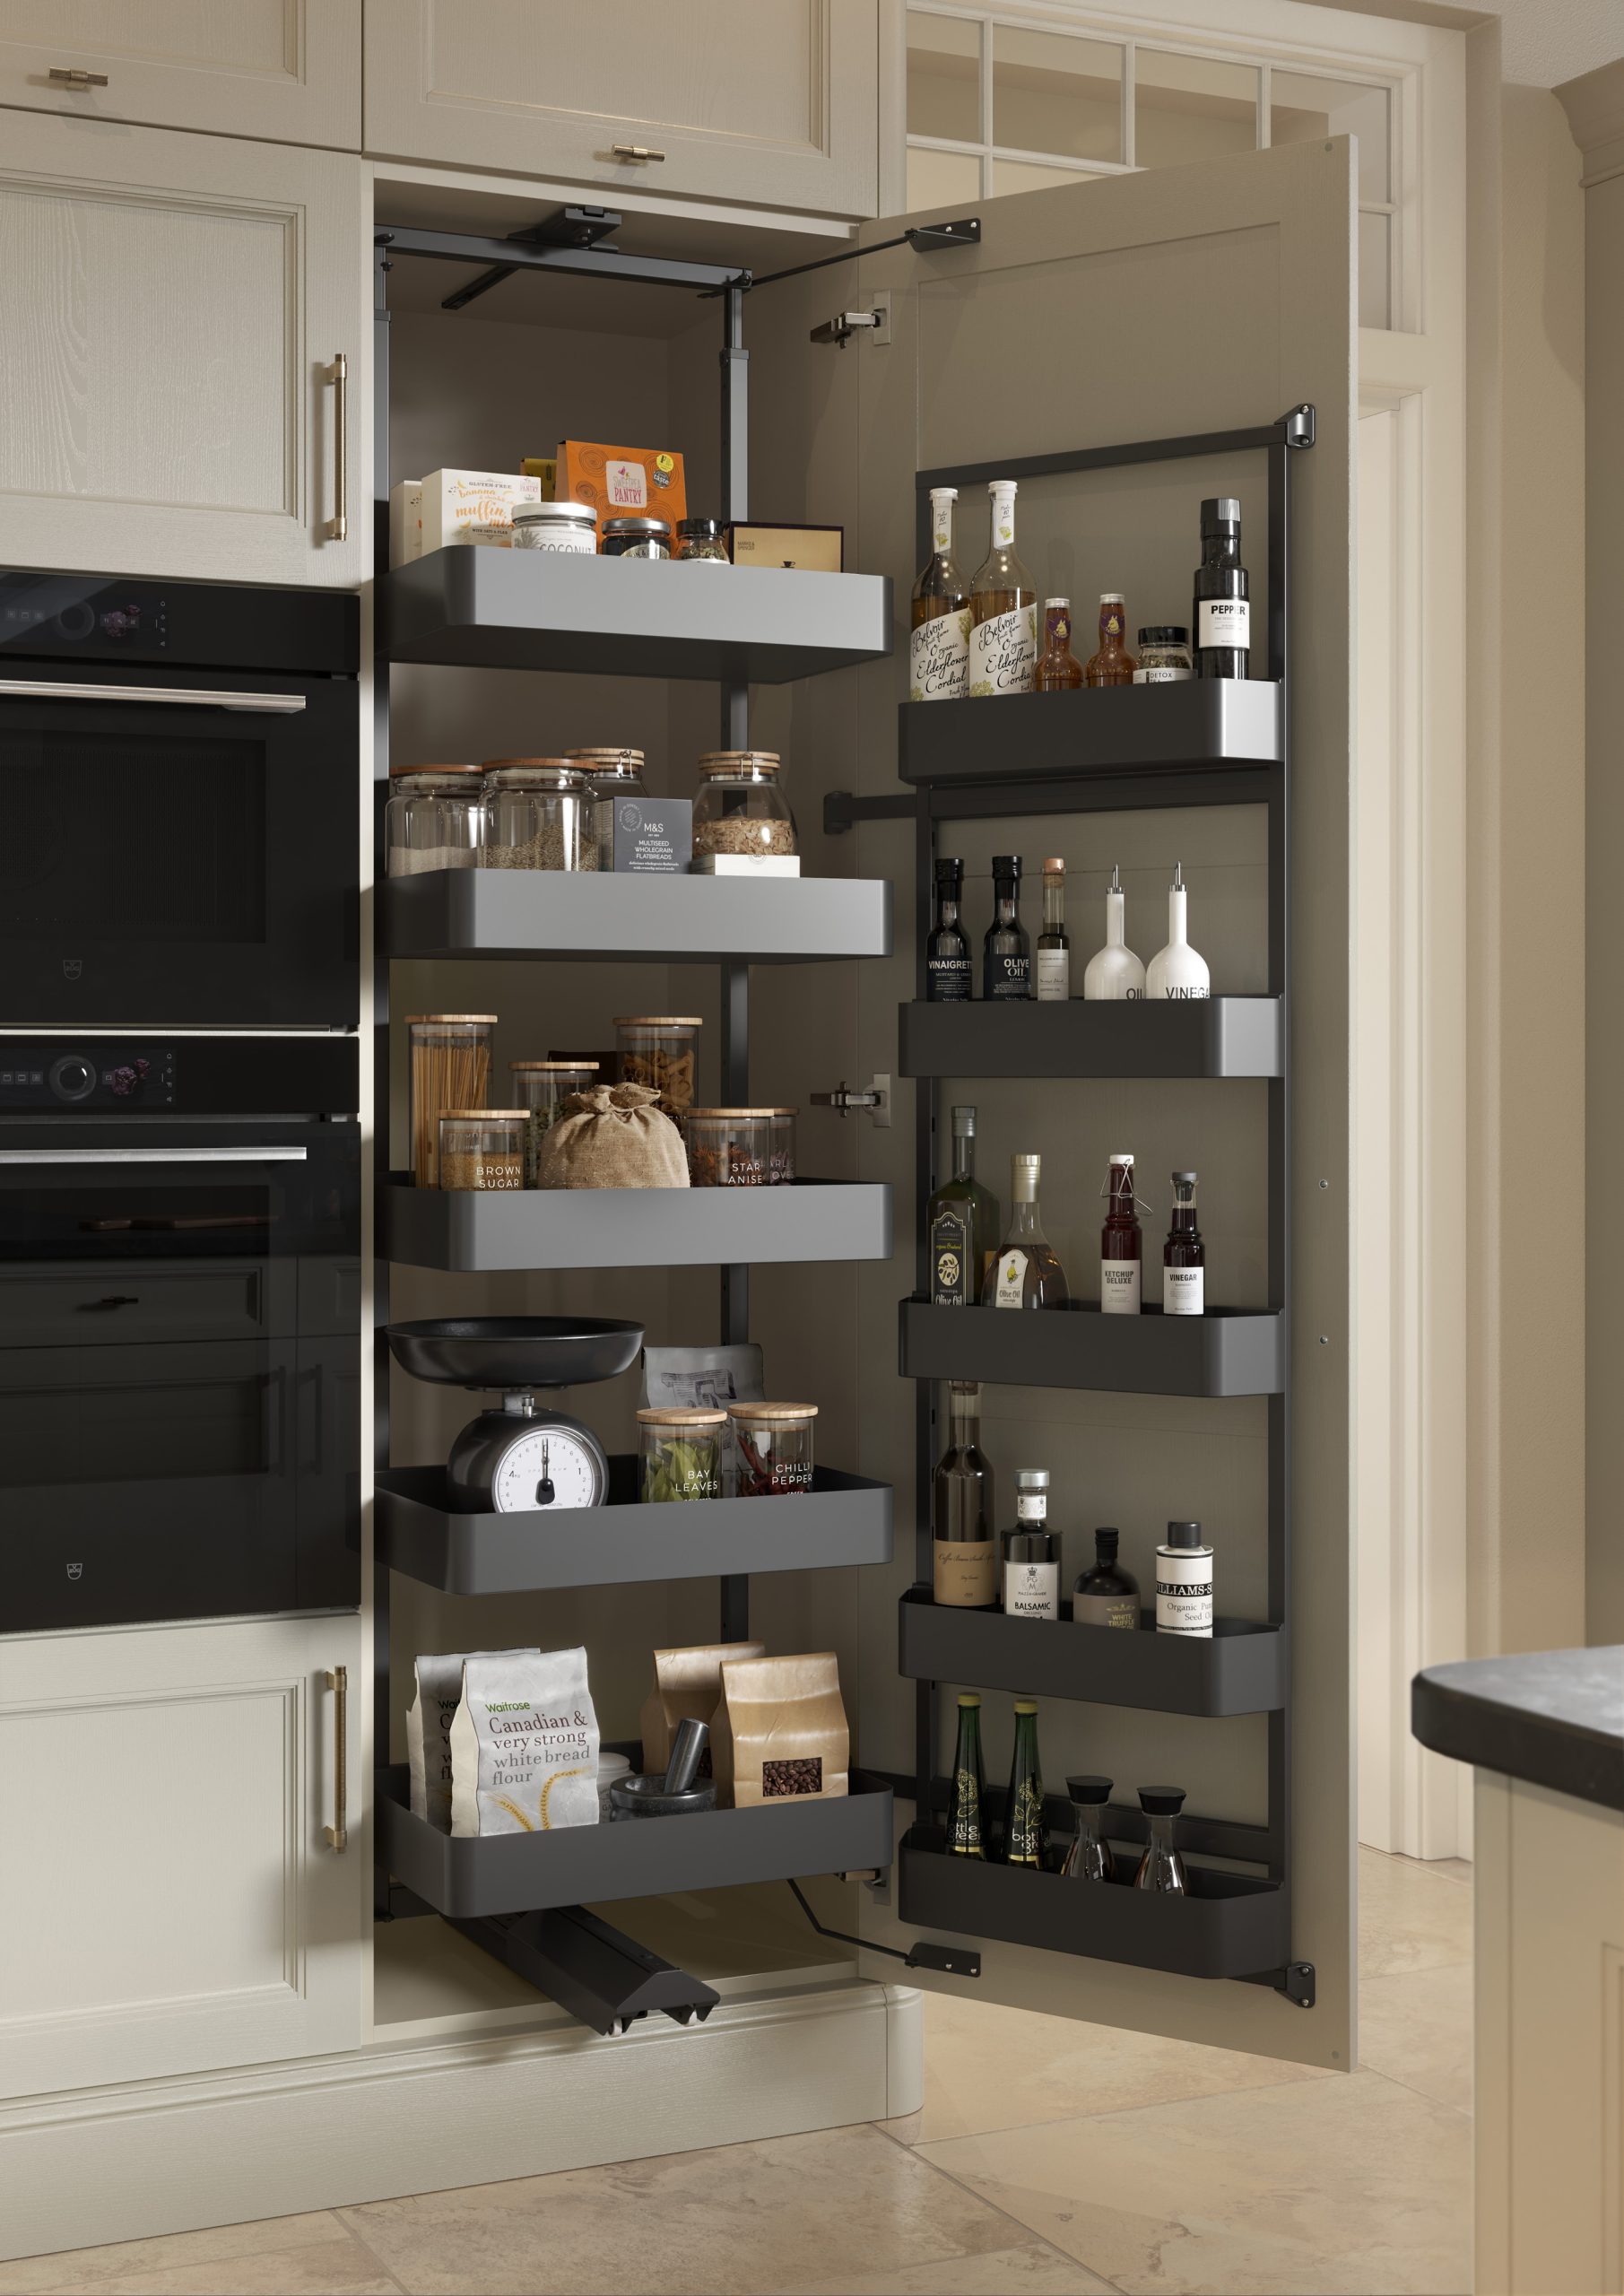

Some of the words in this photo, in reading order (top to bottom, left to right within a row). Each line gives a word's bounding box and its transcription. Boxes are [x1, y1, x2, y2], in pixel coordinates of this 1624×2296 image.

[653, 474, 669, 485] taste
[458, 488, 496, 499] banana
[614, 487, 642, 504] PANTRY
[456, 500, 504, 521] muffin
[912, 620, 946, 657] Belvoir
[978, 614, 1018, 652] Belvoir
[930, 642, 959, 659] Organic
[1002, 638, 1029, 655] Organic
[916, 651, 968, 680] Elderflower
[986, 647, 1036, 674] Elderflower
[925, 665, 967, 693] Cordial
[644, 822, 664, 832] M&S
[1003, 958, 1029, 968] OLIVE
[1007, 968, 1027, 977] OIL
[476, 1166, 521, 1176] BROWN
[732, 1162, 760, 1172] STAR
[479, 1178, 519, 1188] SUGAR
[728, 1175, 762, 1184] ANISE
[1105, 1270, 1134, 1278] KETCHUP
[1169, 1274, 1197, 1282] VINEGAR
[935, 1294, 951, 1305] Olive
[952, 1294, 962, 1305] Oil
[999, 1289, 1012, 1298] Olive
[1012, 1290, 1020, 1299] Oil
[776, 1461, 810, 1474] CHILLI
[688, 1469, 710, 1480] BAY
[771, 1474, 812, 1485] PEPPER
[675, 1480, 717, 1492] LEAVES
[1014, 1602, 1051, 1611] BALSAMIC
[1167, 1603, 1197, 1612] Organic
[485, 1700, 531, 1713] Waitrose
[489, 1713, 570, 1734] Canadian
[574, 1710, 588, 1726] &
[493, 1737, 530, 1752] very
[534, 1731, 586, 1746] strong
[494, 1752, 542, 1769] white
[545, 1745, 590, 1763] bread
[492, 1770, 533, 1786] flour
